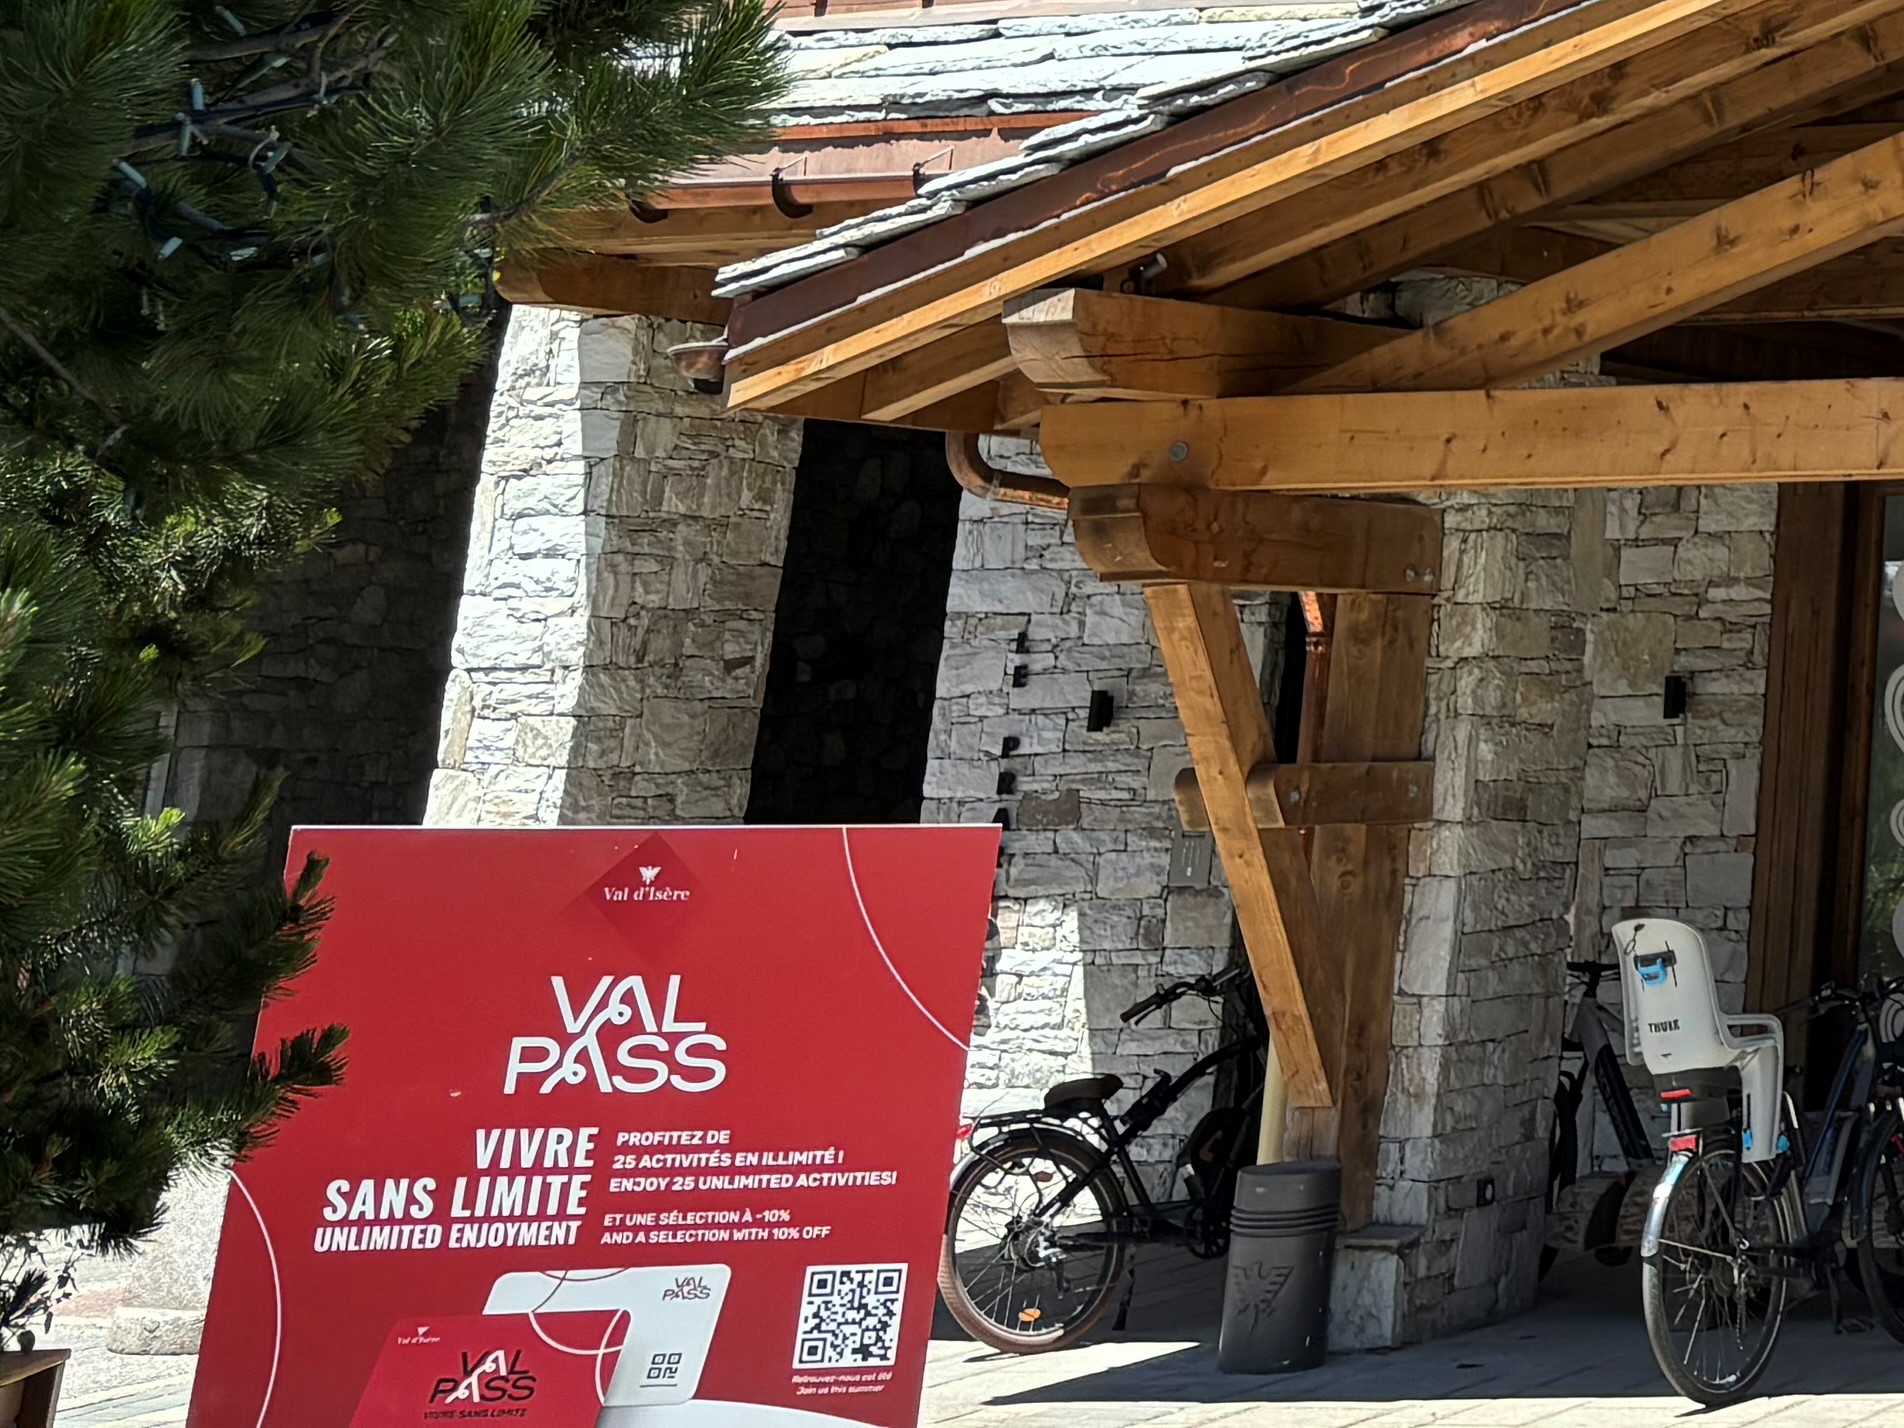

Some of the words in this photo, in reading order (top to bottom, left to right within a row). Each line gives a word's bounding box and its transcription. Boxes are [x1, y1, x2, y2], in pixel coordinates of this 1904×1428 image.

[603, 887, 629, 901] Val
[550, 974, 707, 1034] VAL
[503, 1034, 728, 1095] PASS
[474, 1126, 600, 1170] VIVRE
[615, 1131, 703, 1147] PROFITEZ
[706, 1129, 731, 1145] DE
[612, 1155, 637, 1170] 25
[638, 1150, 732, 1169] ACTIVITÉS
[735, 1152, 759, 1167] EN
[761, 1146, 835, 1166] ILLIMITÉ
[609, 1176, 671, 1193] ENJOY
[672, 1175, 696, 1191] 25
[698, 1173, 794, 1190] UNLIMITED
[795, 1170, 898, 1188] ACTIVITIES!
[322, 1176, 437, 1223] SANS
[450, 1174, 593, 1218] LIMITE
[603, 1213, 625, 1227] ET
[625, 1213, 657, 1226] UNE
[658, 1209, 741, 1225] SÉLECTION
[742, 1208, 753, 1223] À
[755, 1210, 792, 1224] -10%
[313, 1224, 444, 1253] UNLIMITED
[448, 1220, 583, 1249] ENJOYMENT
[600, 1231, 633, 1245] AND
[634, 1231, 647, 1244] A
[648, 1229, 730, 1244] SELECTION
[733, 1228, 770, 1241] WITH
[771, 1227, 800, 1241] 10%
[802, 1226, 832, 1239] OFF
[461, 1348, 531, 1376] VAL
[428, 1374, 538, 1405] PASS
